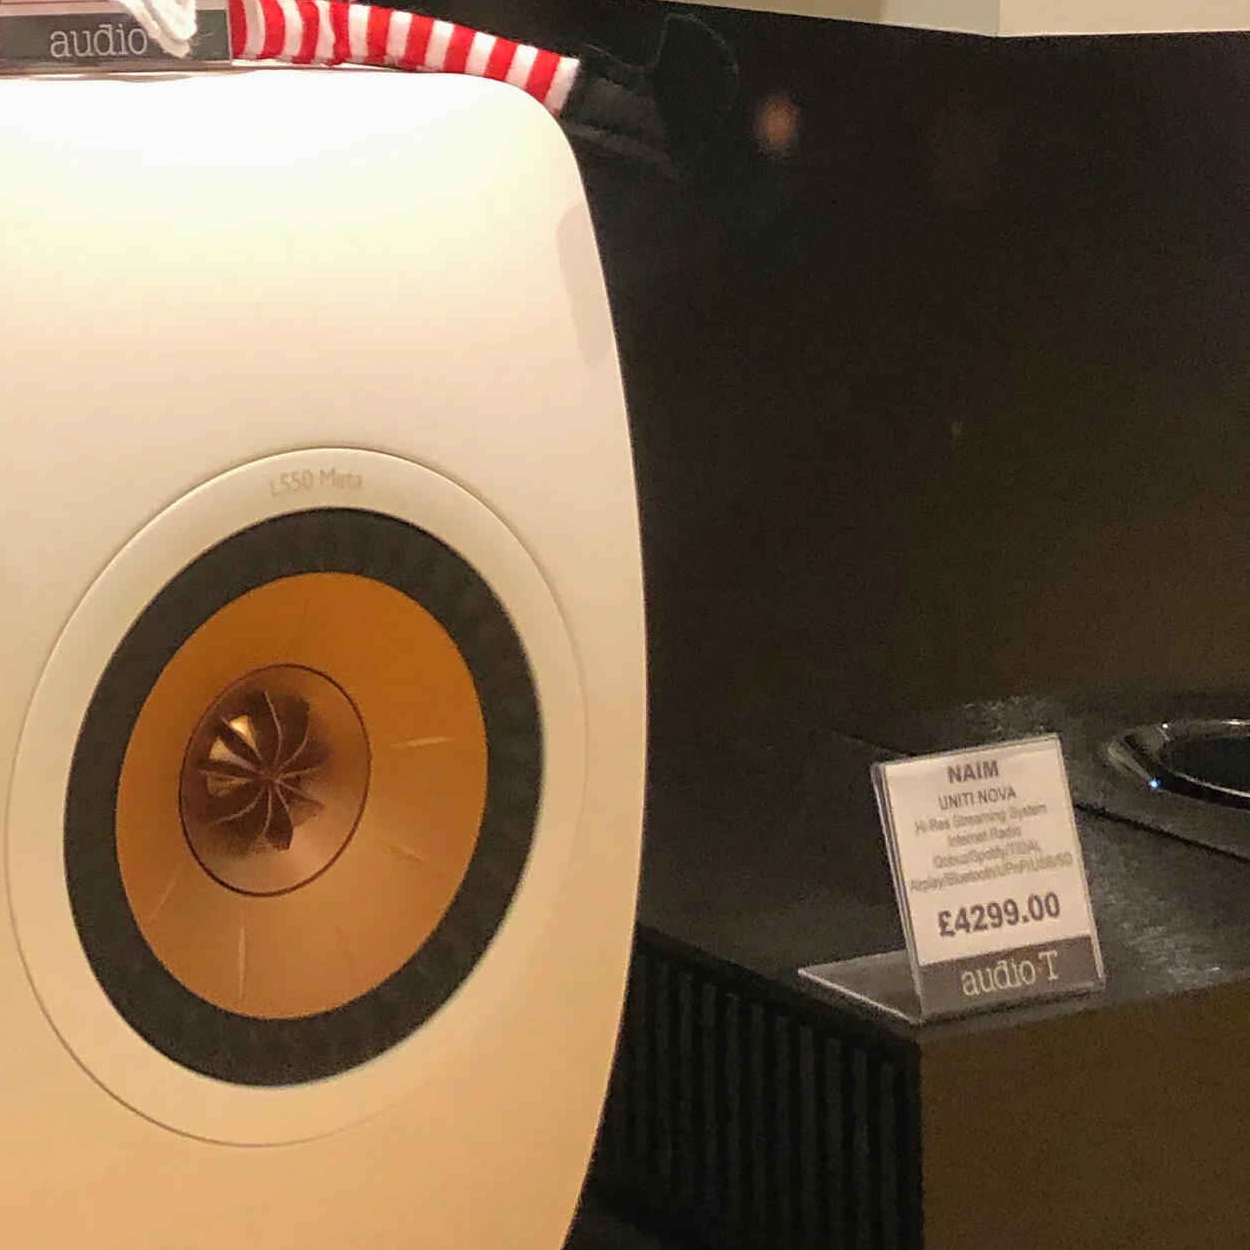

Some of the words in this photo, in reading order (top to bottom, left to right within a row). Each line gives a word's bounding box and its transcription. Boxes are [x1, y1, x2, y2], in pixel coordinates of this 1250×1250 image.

[50, 23, 148, 58] audio
[268, 468, 314, 497] LS50
[318, 466, 363, 491] Meta
[947, 759, 1000, 784] NAIM
[937, 790, 975, 811] UNITI
[978, 785, 1017, 806] NOVA
[1009, 803, 1048, 821] System
[990, 825, 1022, 840] Radio
[937, 892, 1061, 938] £4299.00
